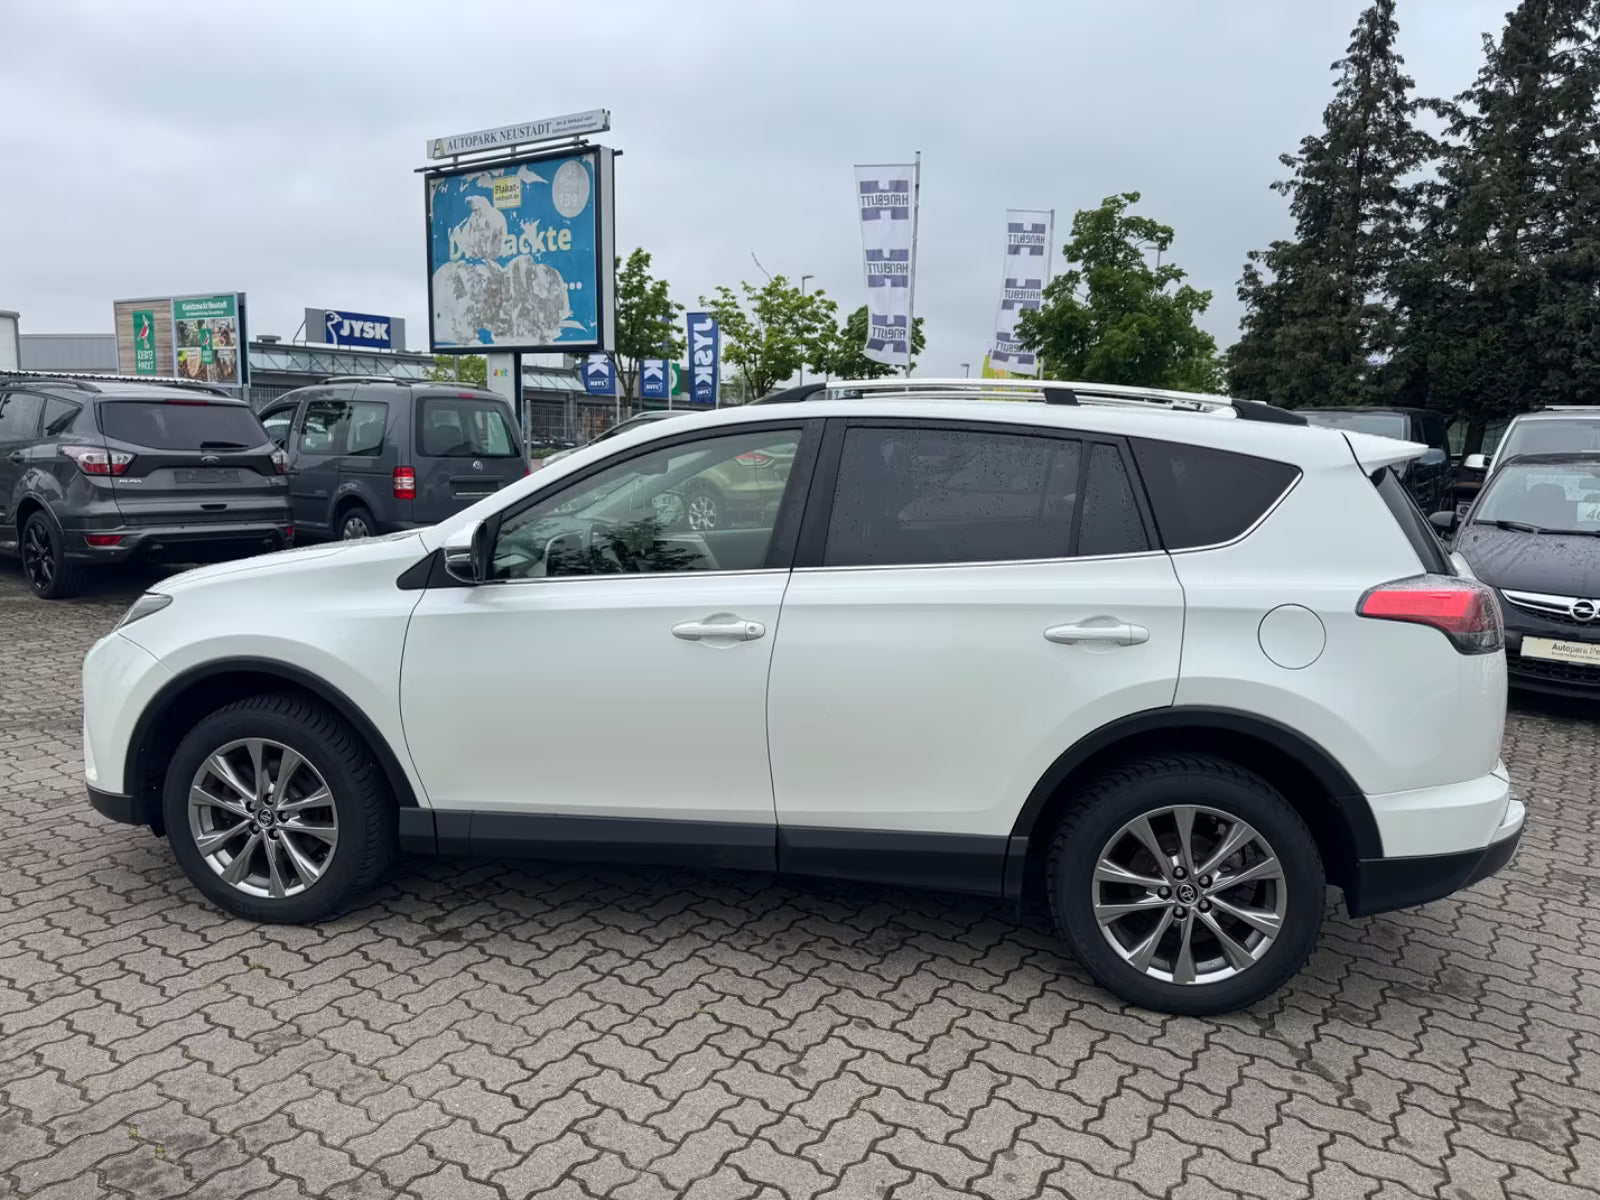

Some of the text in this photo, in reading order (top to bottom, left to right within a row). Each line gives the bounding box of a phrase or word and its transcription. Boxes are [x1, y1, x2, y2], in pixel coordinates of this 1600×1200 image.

[447, 133, 498, 152] AUTOPARK
[499, 121, 552, 143] NEUSTADT
[501, 226, 572, 257] ackte
[339, 319, 390, 341] JYSK
